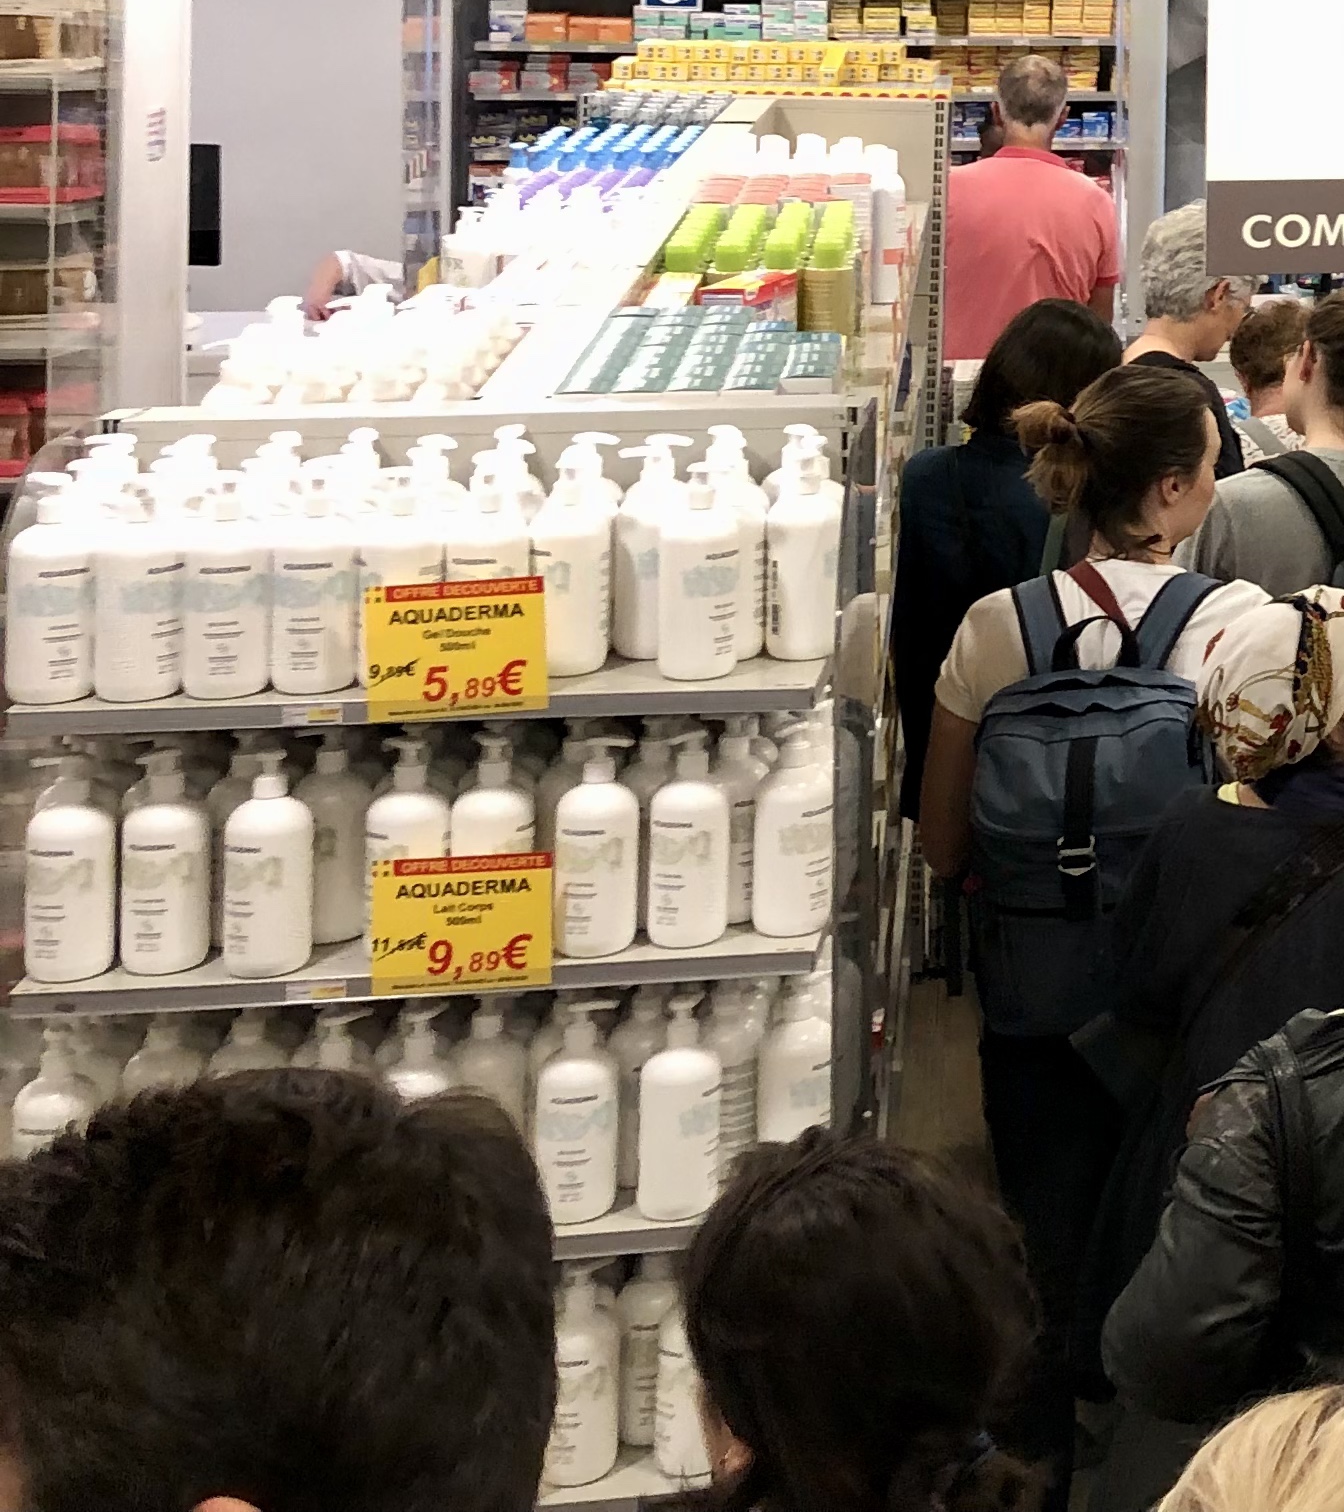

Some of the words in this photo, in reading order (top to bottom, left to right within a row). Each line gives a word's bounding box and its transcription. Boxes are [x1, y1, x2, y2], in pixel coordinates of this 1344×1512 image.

[393, 586, 439, 599] OFFRE
[389, 604, 525, 625] AQUADERMA
[423, 660, 528, 706] 5,89€
[402, 861, 448, 873] OFFRE
[452, 856, 546, 871] DECOUVERTE
[396, 878, 532, 899] AQUADERMA
[459, 903, 494, 912] Corps
[428, 934, 533, 980] 9,89€
